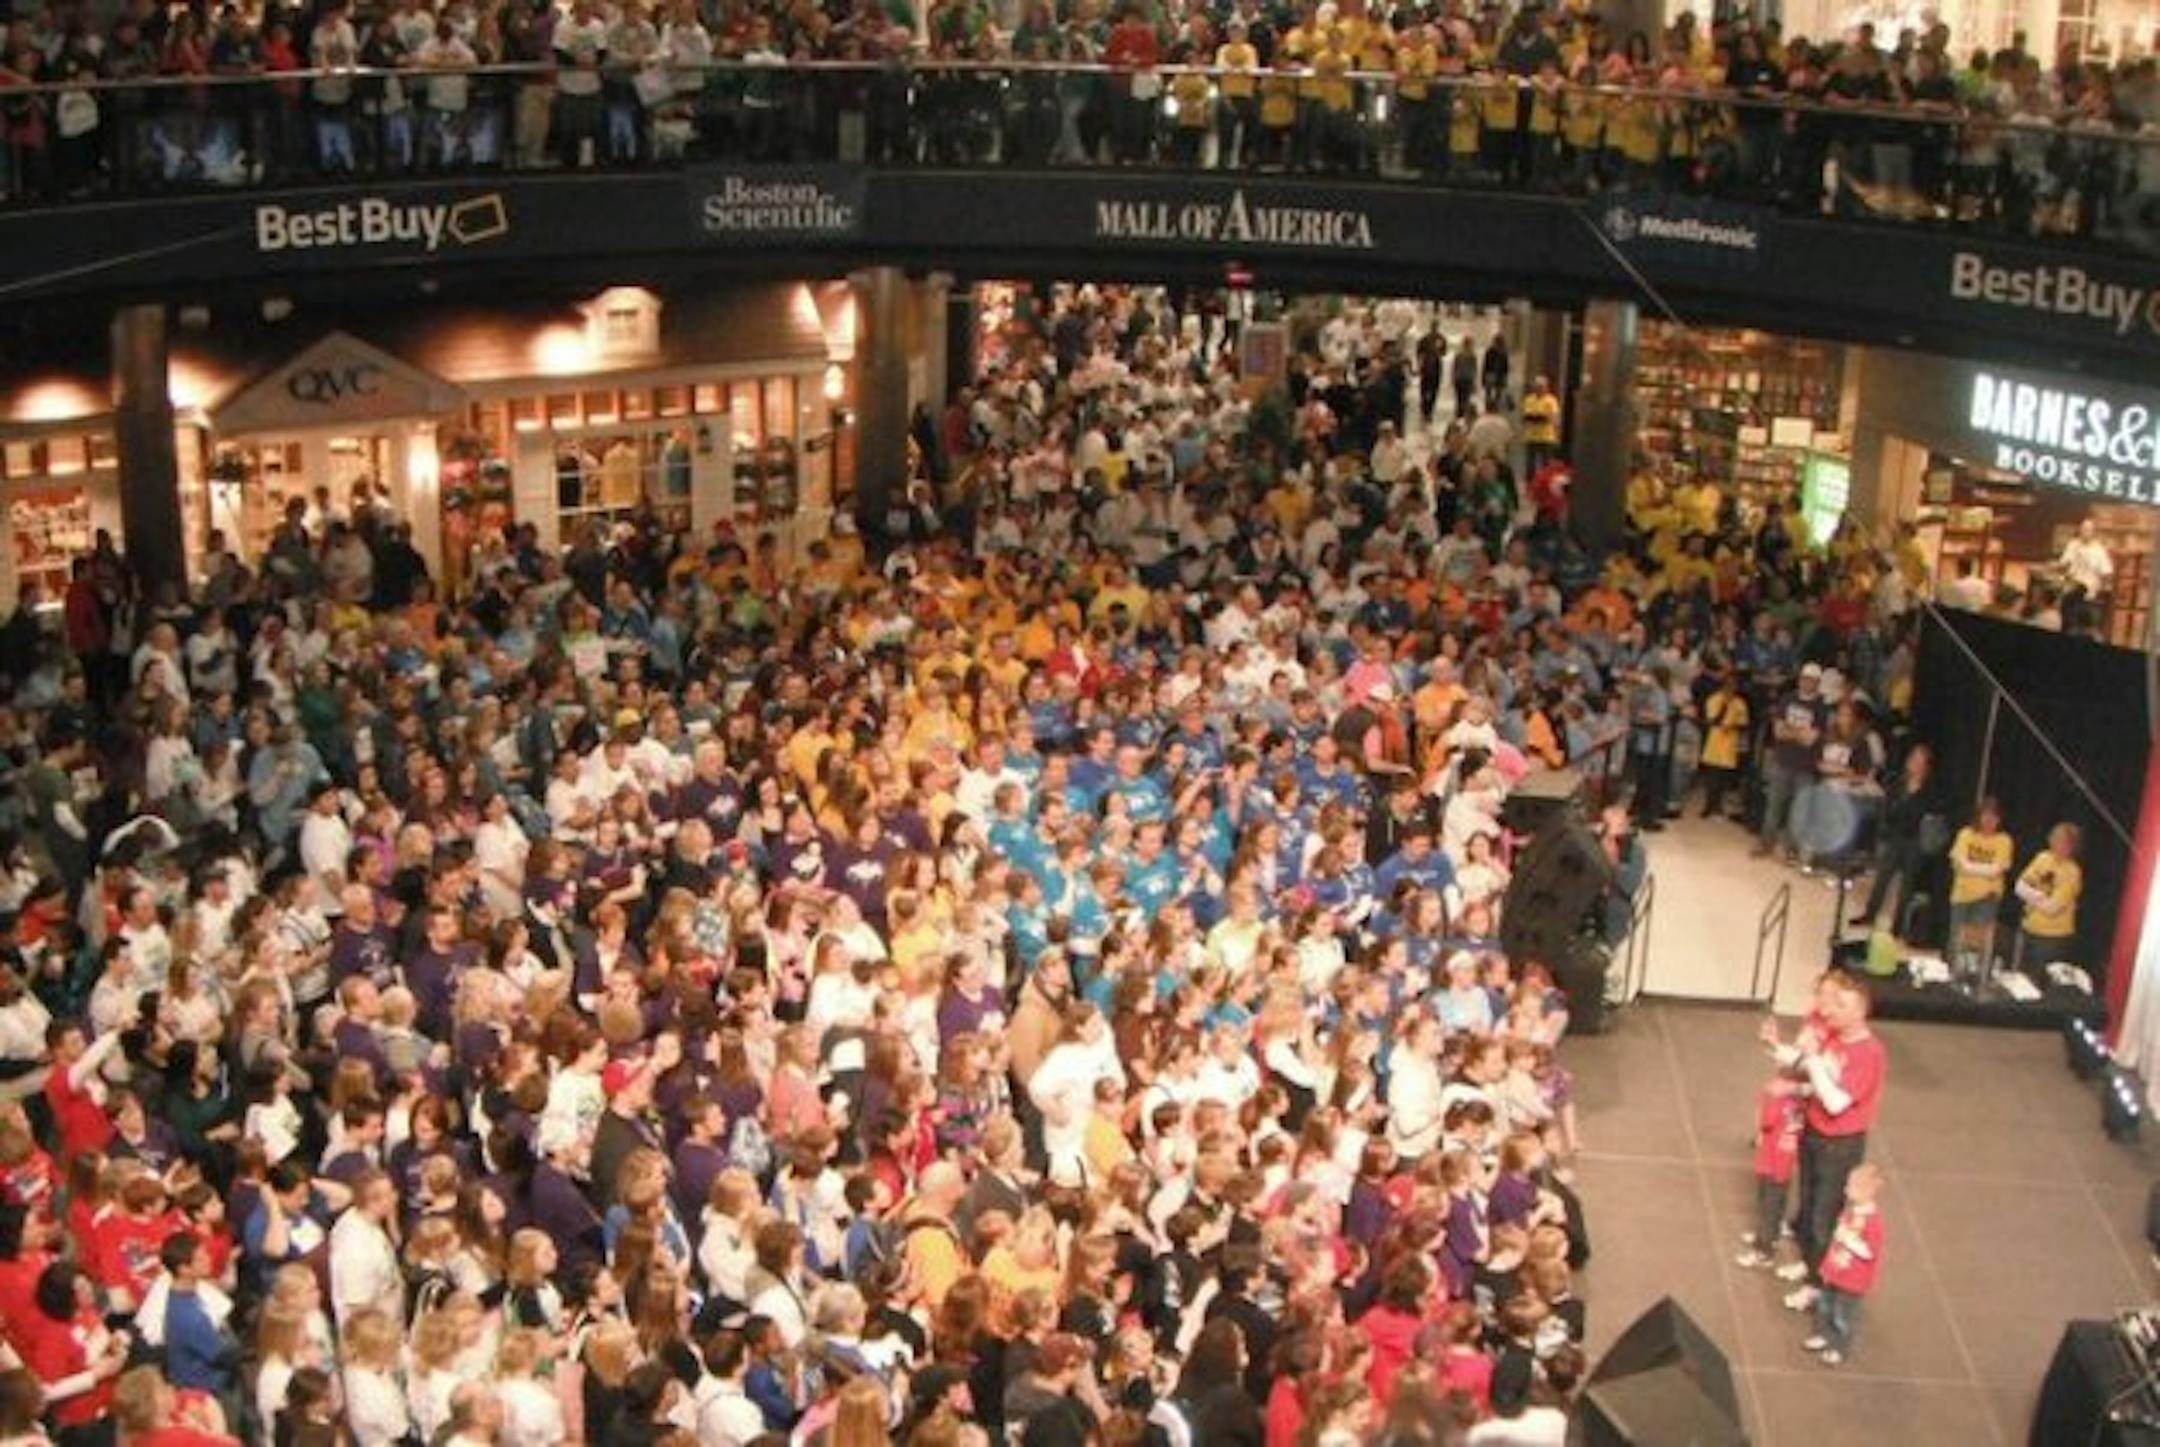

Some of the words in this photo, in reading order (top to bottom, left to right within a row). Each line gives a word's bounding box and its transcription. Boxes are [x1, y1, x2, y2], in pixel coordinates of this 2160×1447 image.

[725, 176, 818, 203] Boston
[704, 193, 851, 230] Scientific
[1096, 200, 1178, 240] MALL
[1179, 204, 1222, 240] OF
[1220, 189, 1374, 248] AMERICA
[288, 364, 382, 405] QVC
